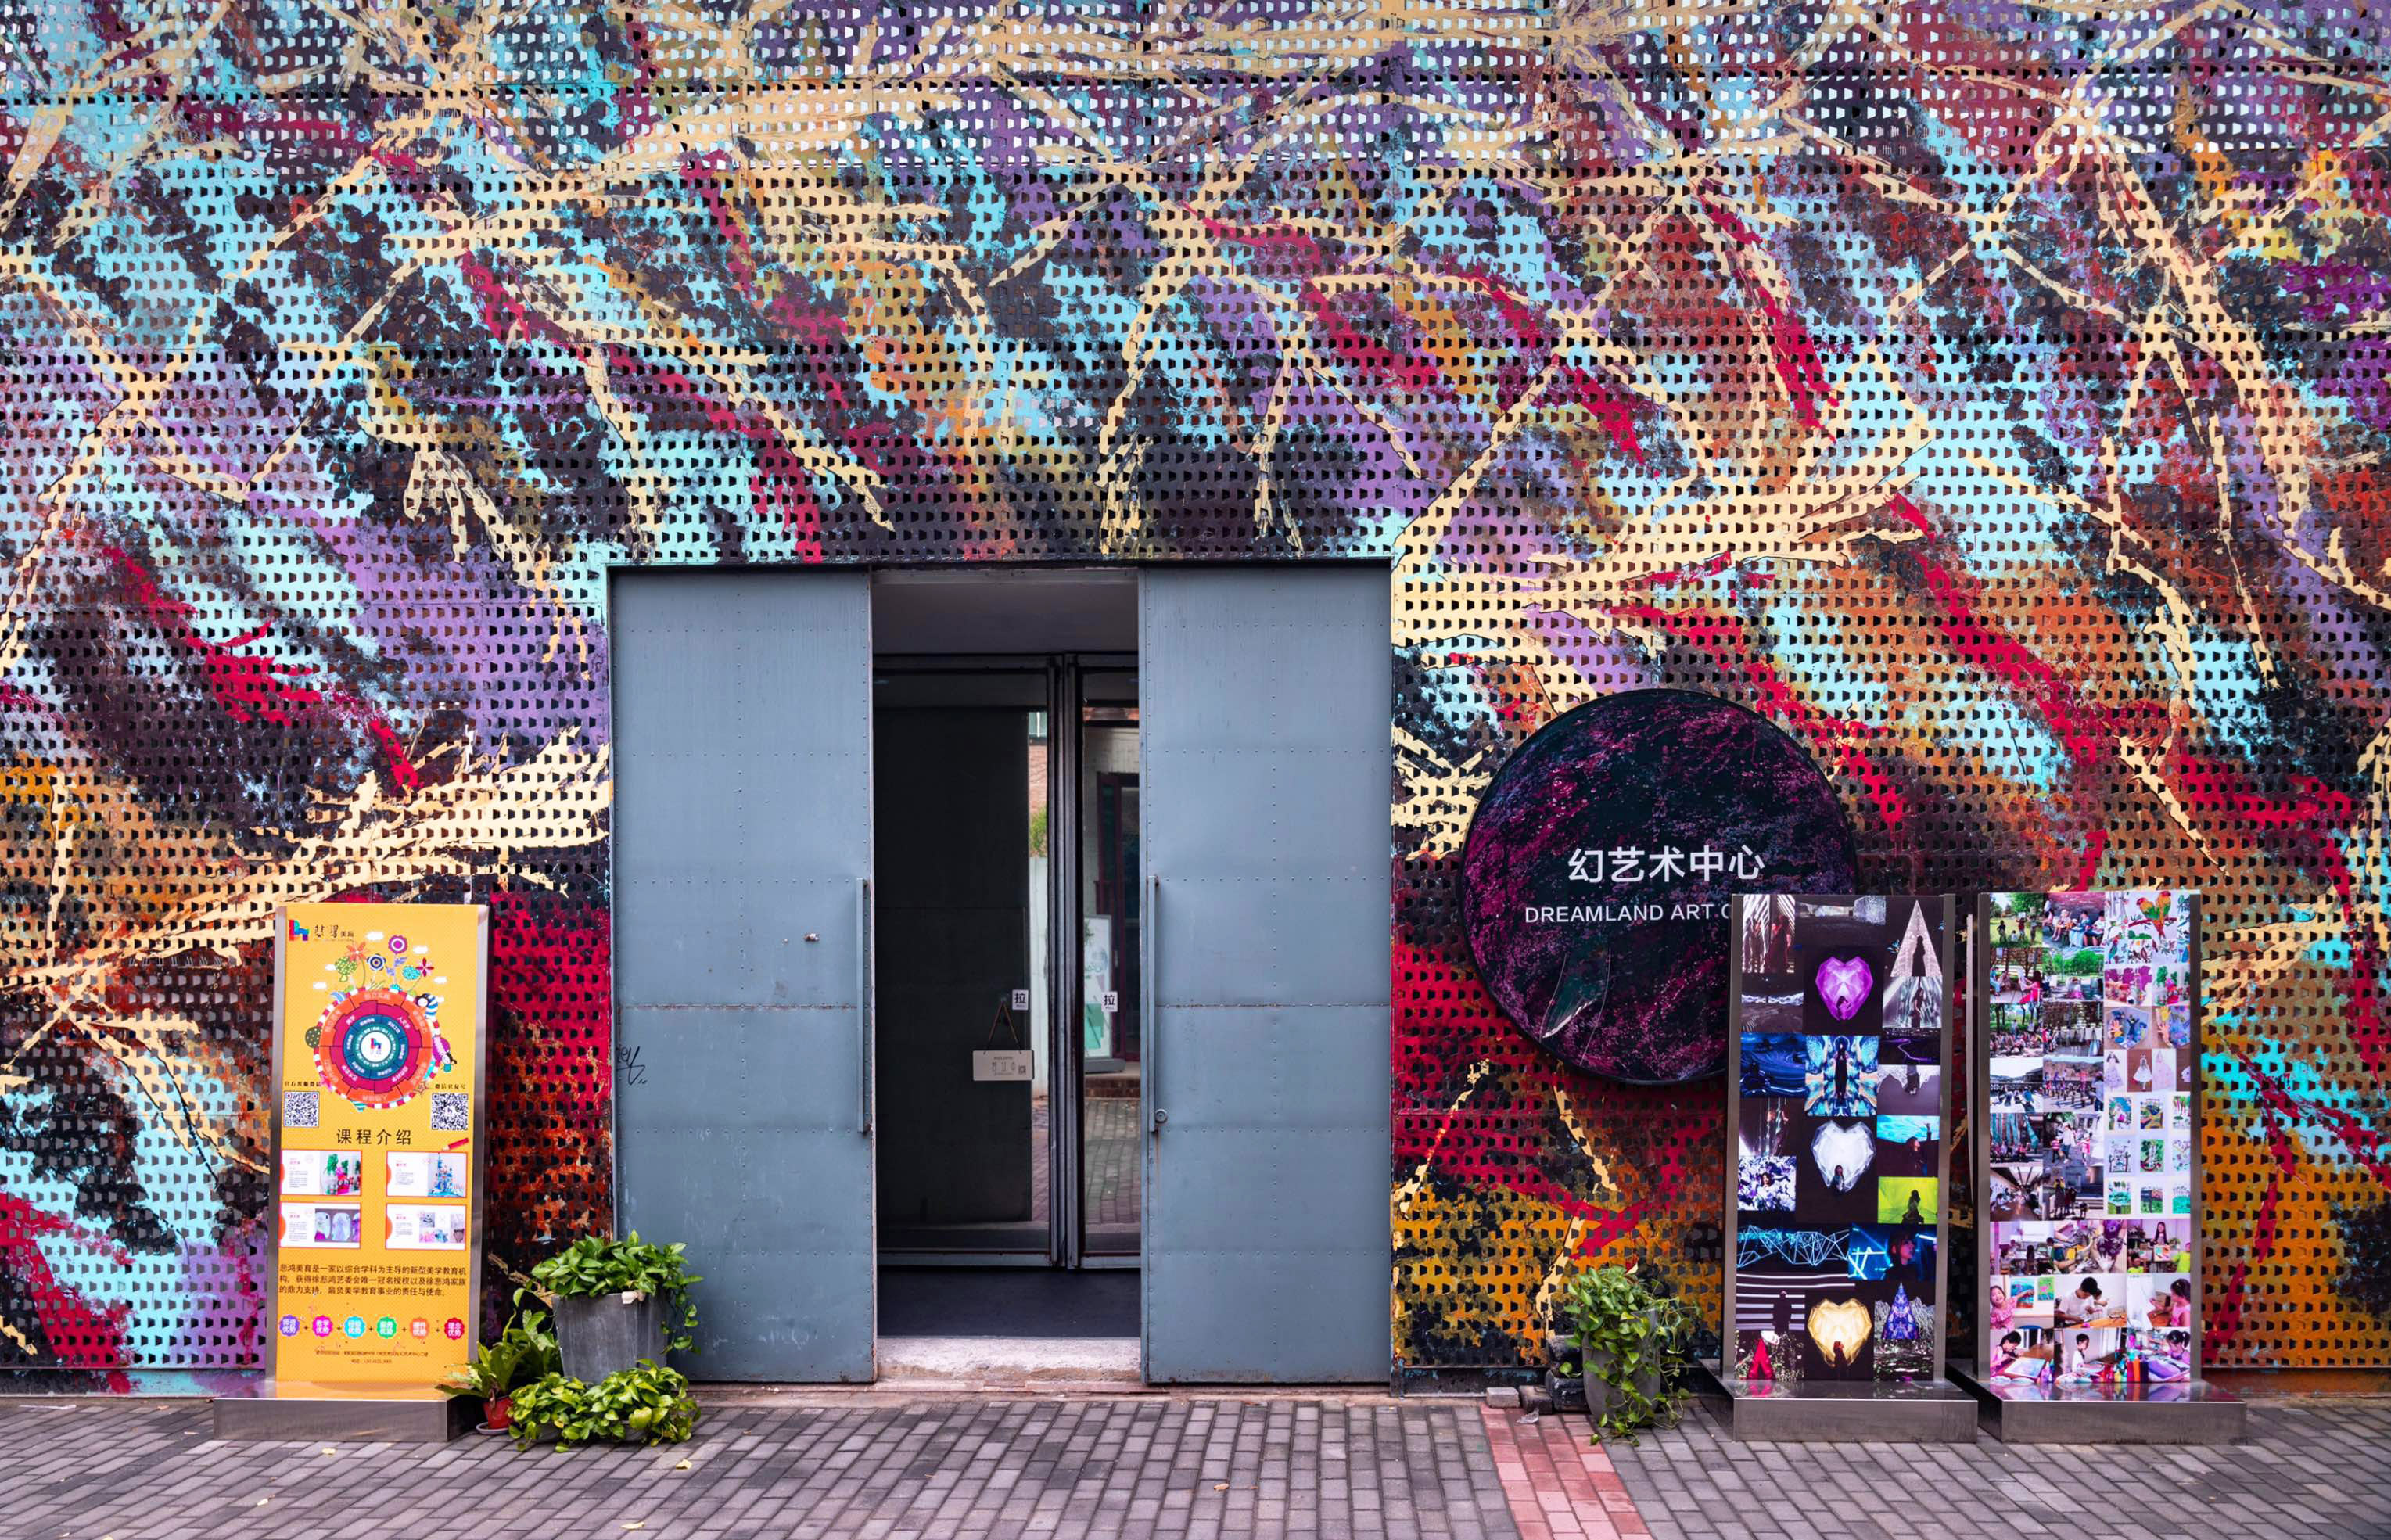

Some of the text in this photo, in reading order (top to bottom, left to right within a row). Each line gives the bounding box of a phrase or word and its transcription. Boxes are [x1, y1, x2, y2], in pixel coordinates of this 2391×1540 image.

[1567, 844, 1765, 884] 幻艺术中心
[1525, 904, 1664, 923] DREAMLAND
[1671, 903, 1713, 921] ART
[1015, 993, 1026, 1004] 拉
[1104, 995, 1115, 1007] 拉
[336, 1129, 412, 1146] 课程介绍
